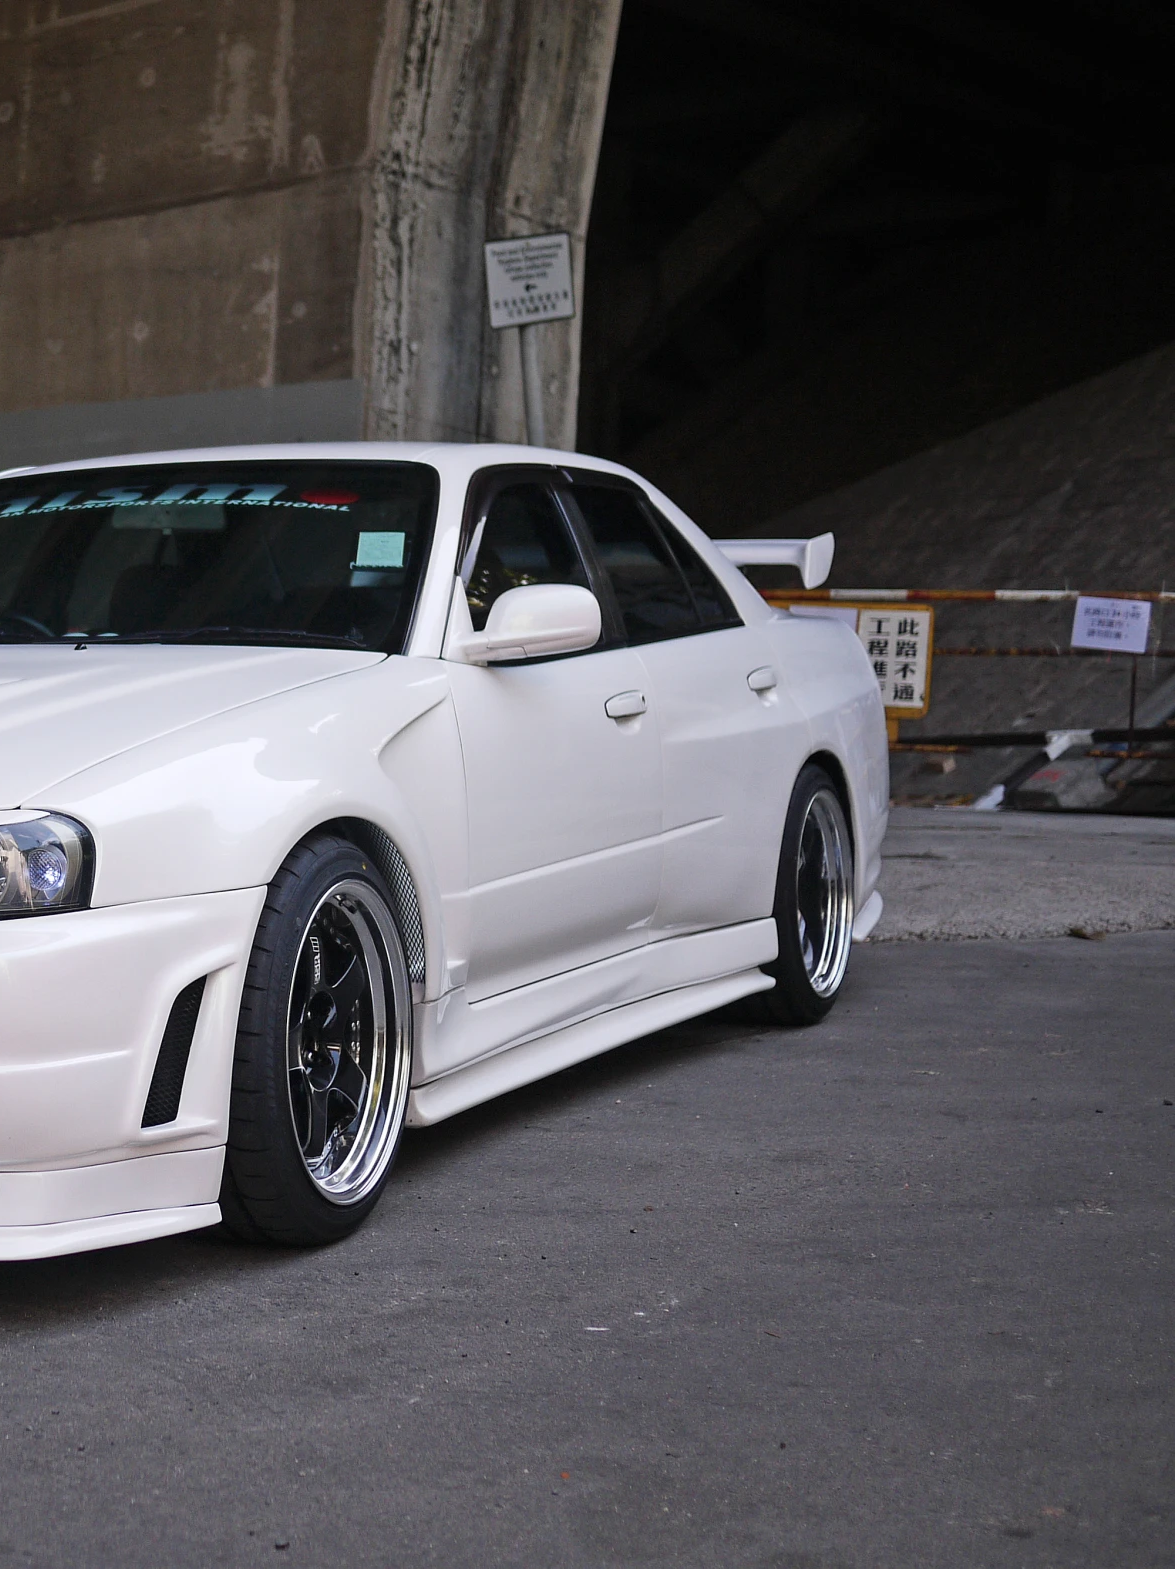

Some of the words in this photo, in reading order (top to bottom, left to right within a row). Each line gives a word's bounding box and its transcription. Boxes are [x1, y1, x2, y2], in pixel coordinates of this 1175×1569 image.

[28, 499, 174, 515] MOTORSPORTS
[178, 499, 351, 512] INTERNATIONAL
[894, 617, 920, 702] 此路不通
